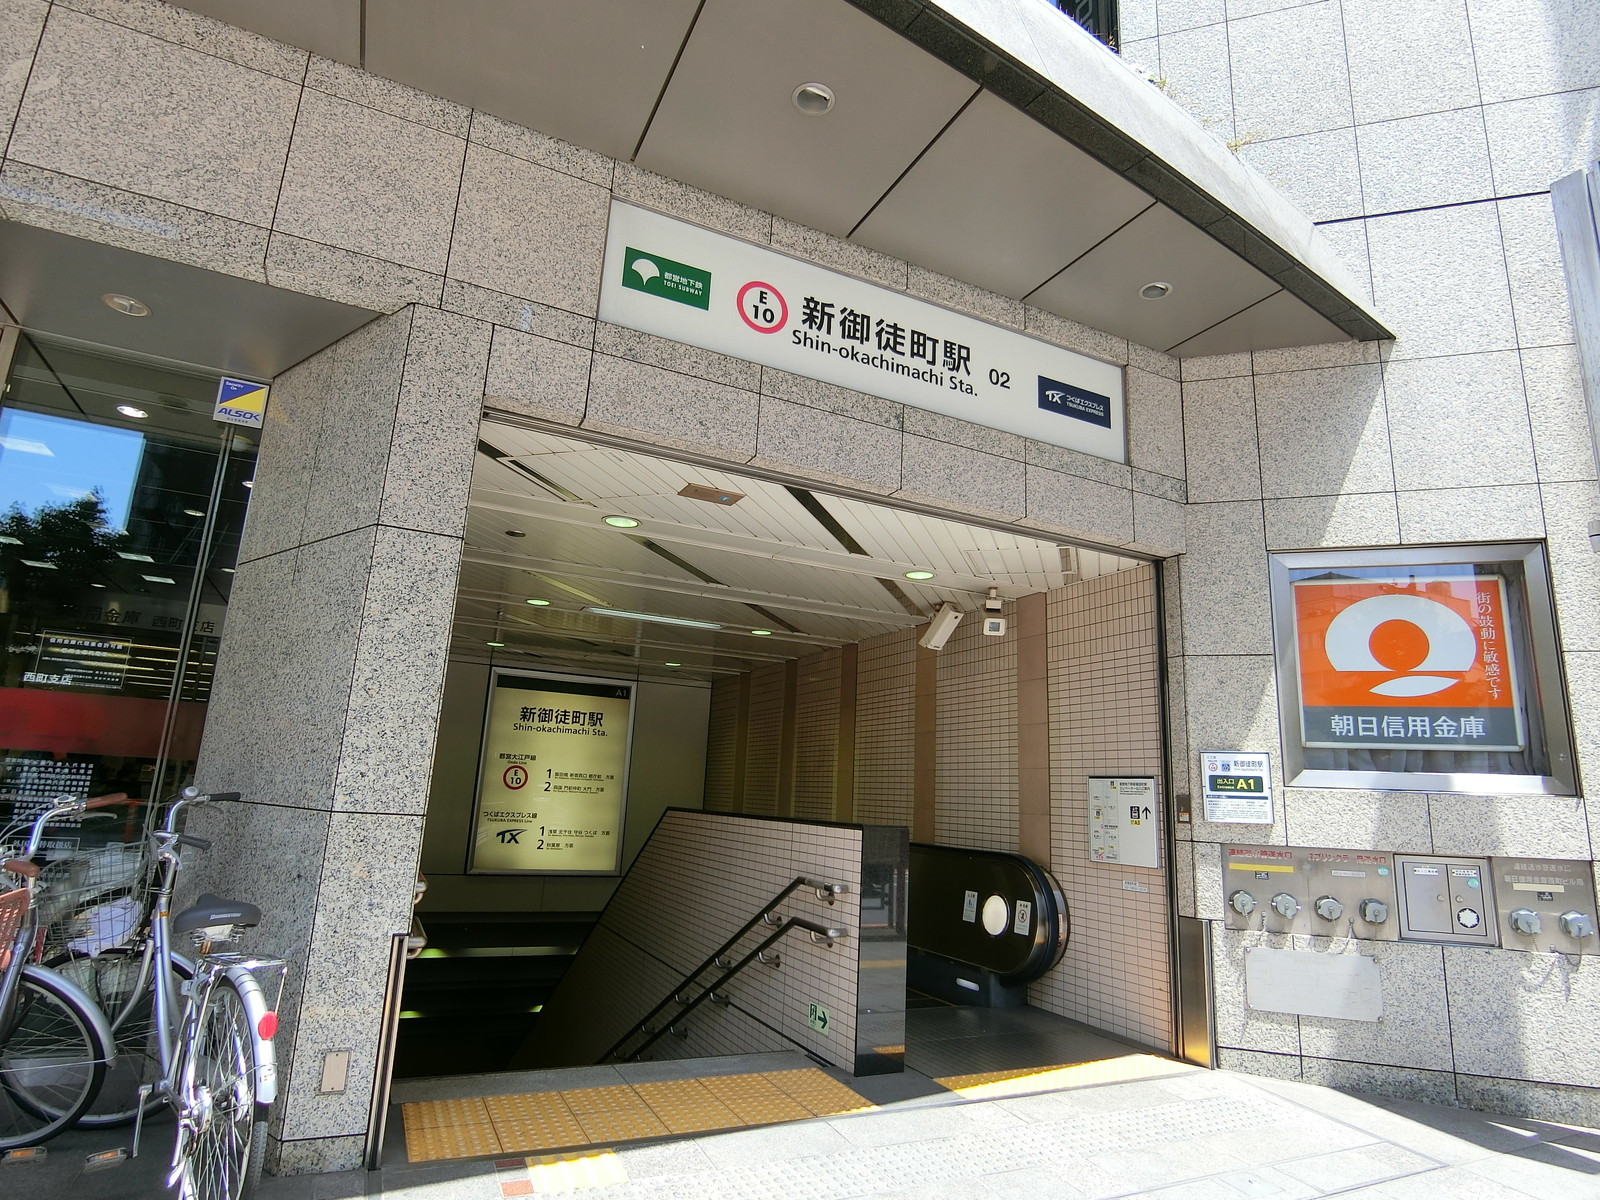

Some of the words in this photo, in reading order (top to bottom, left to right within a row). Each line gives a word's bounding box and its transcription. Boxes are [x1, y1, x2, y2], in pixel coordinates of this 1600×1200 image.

[663, 279, 677, 289] TOEI
[678, 284, 703, 296] SUBWAY
[664, 271, 703, 290] 都営地下鉄
[758, 290, 767, 305] E
[752, 304, 775, 324] 10
[801, 296, 972, 377] 新御徒町駅
[791, 329, 944, 387] Shin-okachimachi
[949, 375, 978, 397] Sta.
[988, 368, 1011, 390] 02
[1045, 390, 1066, 405] TX
[1066, 393, 1105, 412] つくばエクスプレス
[218, 407, 260, 422] ALSOK
[1065, 400, 1086, 412] TSUKUBA
[1085, 405, 1105, 417] EXPRESS
[1475, 592, 1502, 700] 街の鼓動に敏感です
[22, 671, 74, 686] 西町支店
[616, 689, 628, 697] A1
[519, 706, 604, 728] 新御徒町駅
[512, 722, 590, 736] Shin-okachimachi
[592, 728, 609, 738] Sta.
[1330, 714, 1487, 739] 朝日信用金庫
[499, 752, 537, 762] 都営大江戸線
[510, 776, 522, 785] 10
[513, 769, 519, 777] E
[546, 768, 552, 779] 1
[543, 781, 552, 792] 2
[1236, 778, 1255, 790] A1
[483, 811, 538, 819] つくばエクスプレス線
[495, 828, 529, 845] TX
[539, 825, 545, 837] 1
[536, 839, 545, 850] 2
